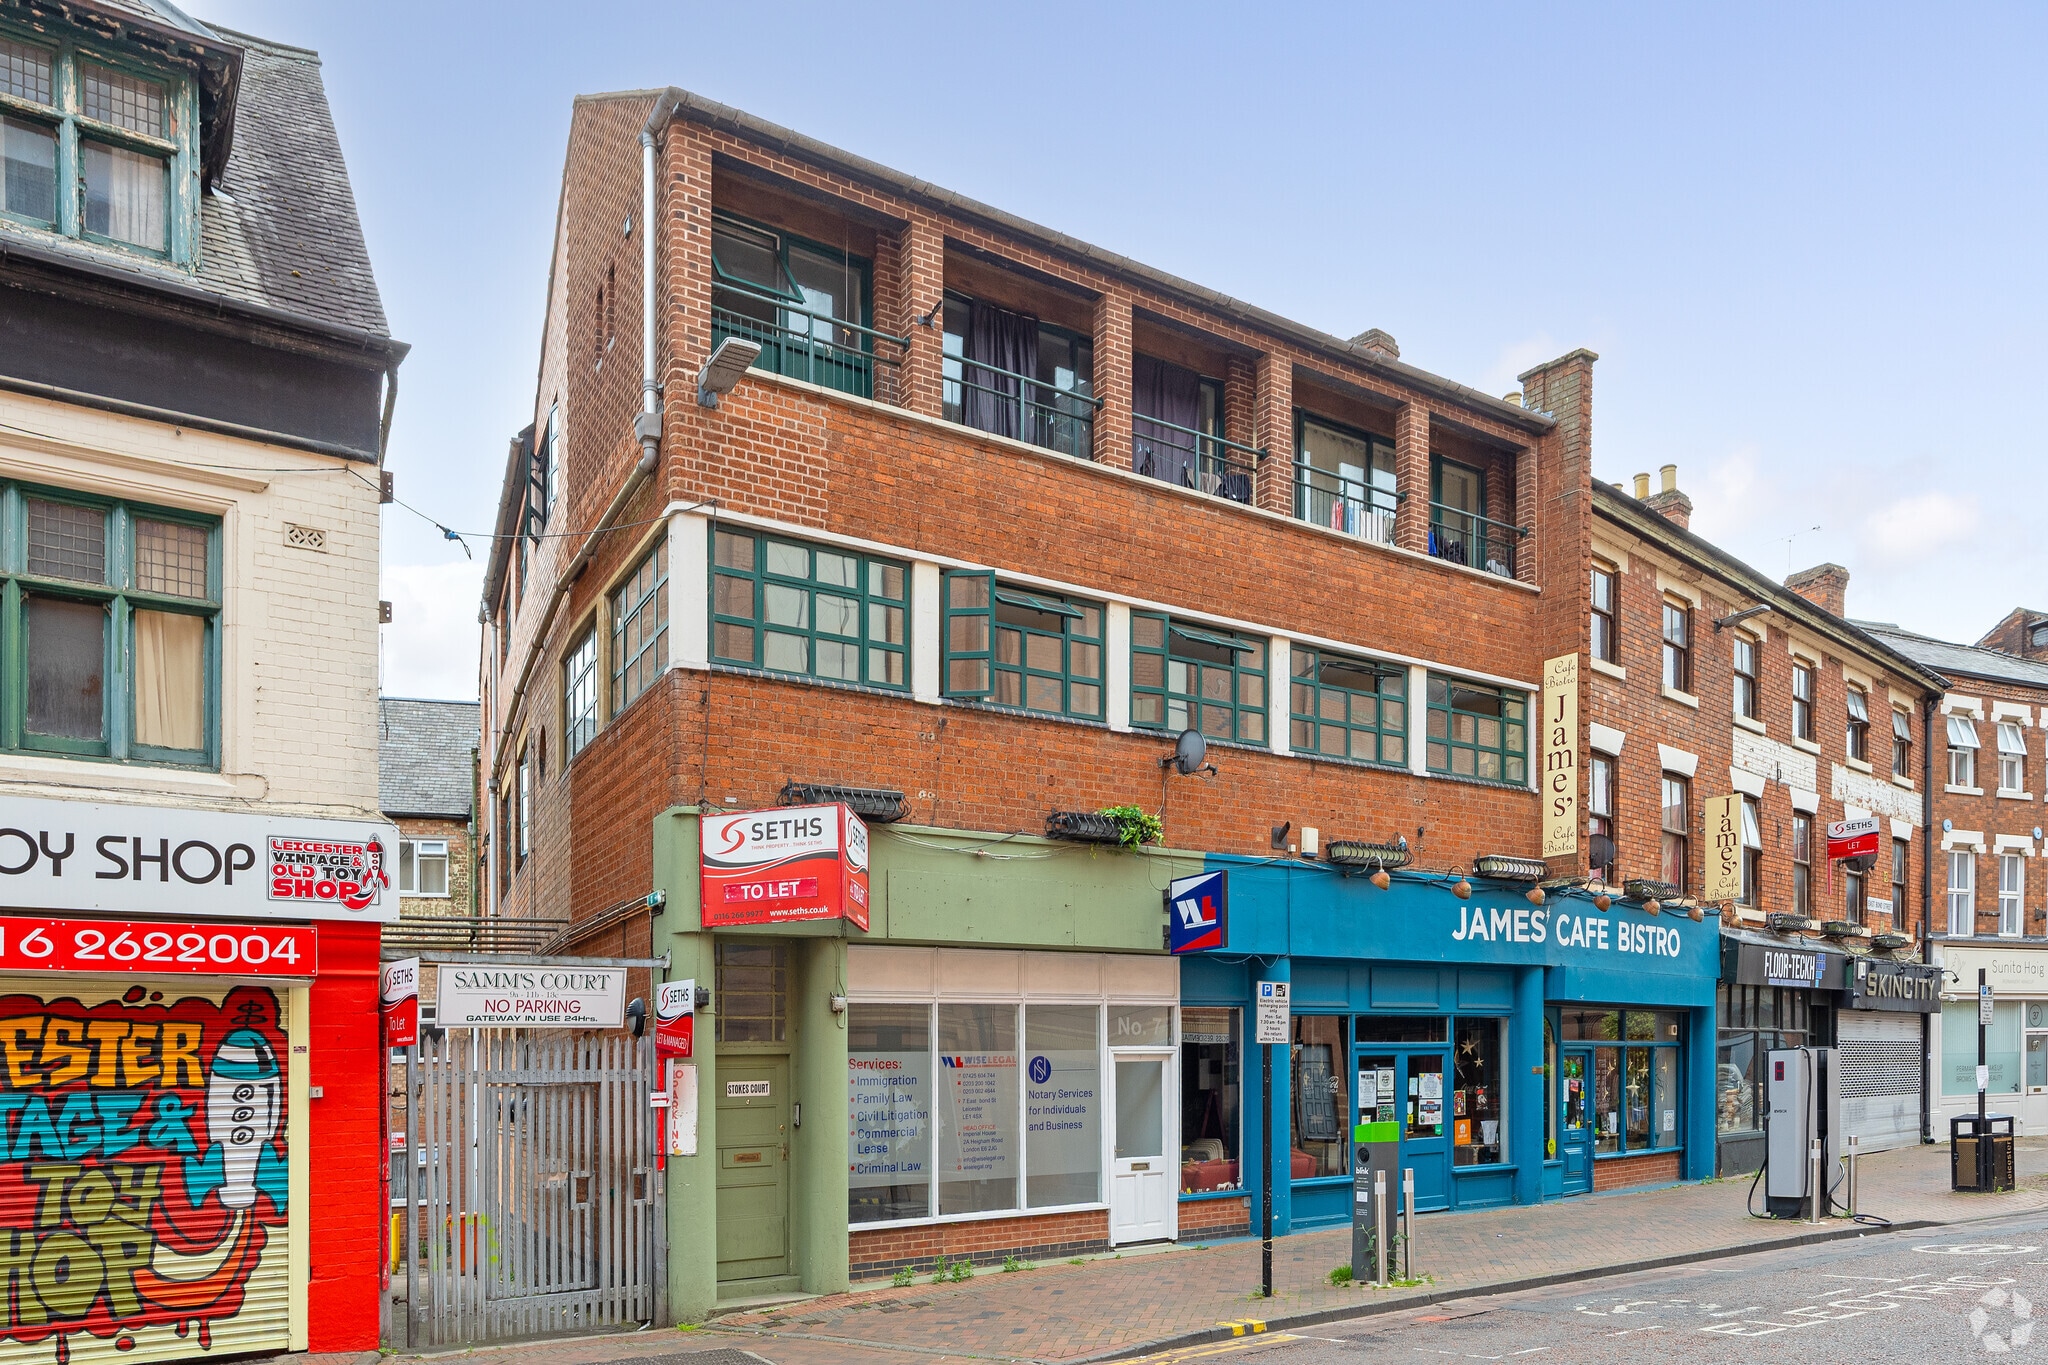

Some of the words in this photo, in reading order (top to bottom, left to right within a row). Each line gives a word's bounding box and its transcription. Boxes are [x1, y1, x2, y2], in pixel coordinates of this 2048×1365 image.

[1555, 660, 1576, 676] Cafe
[1545, 675, 1576, 690] Bistro
[752, 818, 822, 841] SETHS
[1846, 821, 1872, 830] SETHS
[1553, 826, 1574, 842] Cafe
[272, 841, 362, 855] LEICESTER
[1544, 840, 1575, 854] Bistro
[95, 836, 255, 885] SHOP
[273, 852, 350, 866] VINTAGE
[352, 856, 362, 867] &
[273, 864, 315, 878] OLD
[323, 867, 361, 881] TOY
[273, 878, 360, 900] SHOP
[741, 884, 764, 899] TO
[768, 881, 800, 897] LET
[1719, 877, 1739, 891] Cafe
[1710, 889, 1738, 899] Bistro
[770, 905, 828, 916] www.seths.co.uk
[1556, 914, 1609, 949] CAFE
[1618, 921, 1680, 957] BISTRO
[74, 929, 300, 964] 2622004
[1764, 952, 1816, 980] FLOOR-TECKH
[1992, 959, 2021, 974] Sunita
[2025, 961, 2044, 978] Haig
[393, 968, 413, 985] SETHS
[455, 971, 535, 990] SAMM'S
[541, 973, 611, 990] COURT
[1867, 973, 1936, 999] SKINCITY
[669, 988, 689, 1003] SETHS
[484, 1000, 510, 1013] NO
[516, 1000, 581, 1013] PARKING
[389, 1017, 396, 1030] To
[396, 1016, 405, 1030] Let
[1118, 1017, 1146, 1035] No.
[1153, 1018, 1161, 1035] 7
[666, 1034, 687, 1050] MANAGED
[849, 1058, 902, 1069] Services:
[673, 1069, 683, 1079] O
[728, 1084, 749, 1094] STOKES
[750, 1083, 768, 1093] COURT
[857, 1075, 917, 1088] Immigration
[857, 1093, 890, 1105] Family
[893, 1093, 912, 1103] Law
[1028, 1090, 1056, 1100] Notary
[1058, 1088, 1093, 1098] Services
[858, 1110, 879, 1122] Civil
[881, 1110, 928, 1122] Litigation
[1028, 1106, 1041, 1115] for
[1043, 1104, 1086, 1114] Individuals
[858, 1127, 917, 1139] Commercial
[1028, 1122, 1044, 1131] and
[1046, 1121, 1083, 1130] Business
[858, 1144, 888, 1154] Lease
[858, 1162, 898, 1174] Criminal
[901, 1162, 921, 1172] Law
[30, 1165, 160, 1230] TOY
